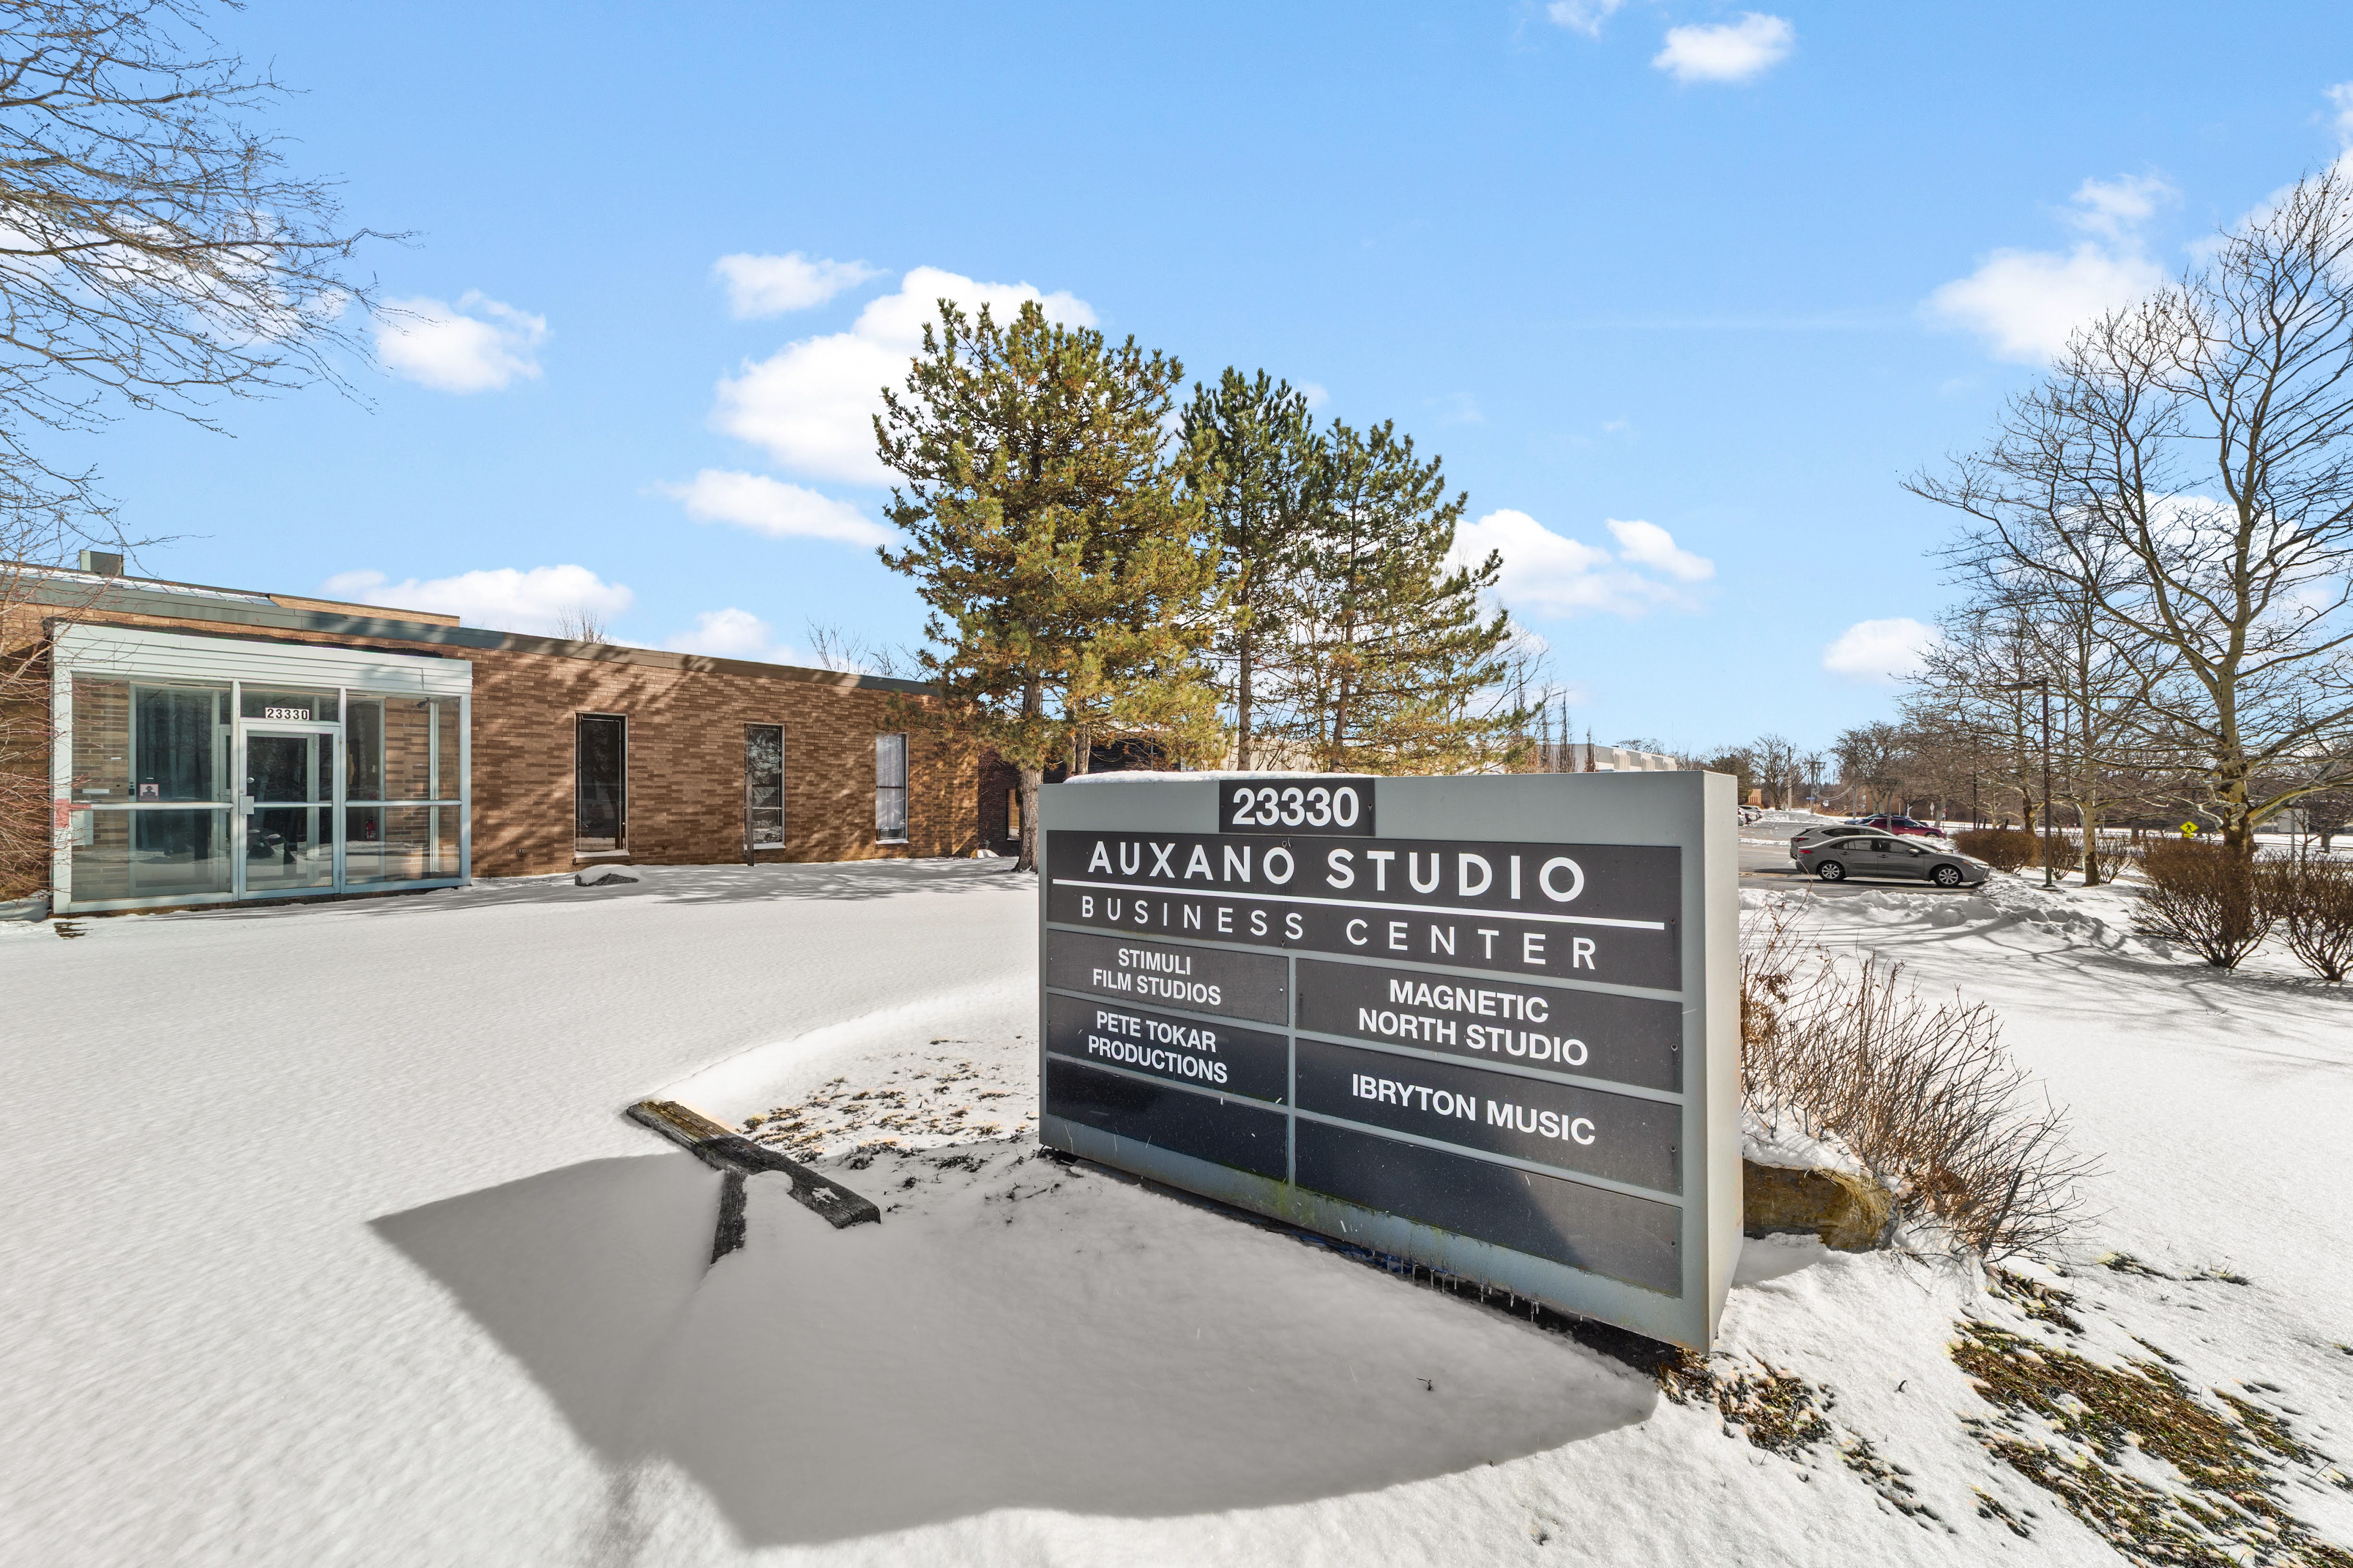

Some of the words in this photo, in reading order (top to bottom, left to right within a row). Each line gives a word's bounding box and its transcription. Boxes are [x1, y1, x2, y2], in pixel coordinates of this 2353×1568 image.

[268, 708, 307, 719] 23330
[1232, 787, 1359, 827] 23330
[1087, 840, 1295, 885] AUXANO
[1325, 848, 1585, 902] STUDIO
[1082, 895, 1304, 940] BUSINESS
[1345, 918, 1596, 971] CENTER
[1118, 948, 1191, 976] STIMULI
[1093, 968, 1132, 992] FILM
[1136, 974, 1221, 1006] STUDIOS
[1390, 978, 1549, 1023] MAGNETIC
[1096, 1010, 1141, 1038] PETE
[1145, 1020, 1217, 1053] TOKAR
[1358, 1007, 1457, 1046] NORTH
[1465, 1023, 1588, 1066] STUDIO
[1088, 1034, 1228, 1084] PRODUCTIONS
[1352, 1073, 1476, 1121] IBRYTON
[1487, 1099, 1596, 1146] MUSIC
